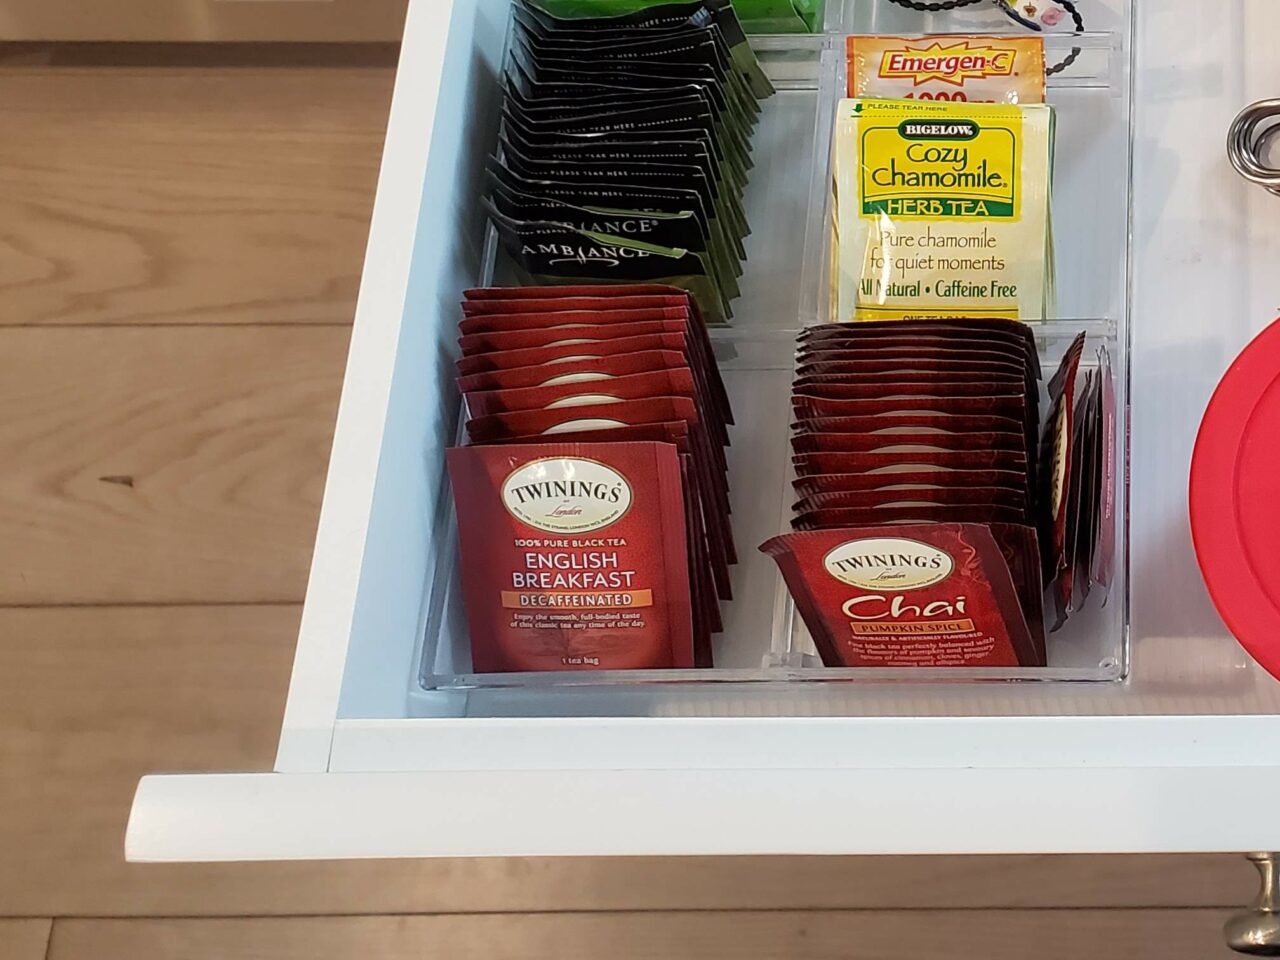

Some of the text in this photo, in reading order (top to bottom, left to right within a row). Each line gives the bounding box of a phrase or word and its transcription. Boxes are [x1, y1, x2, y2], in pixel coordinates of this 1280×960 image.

[888, 53, 1009, 75] Emergen-C
[905, 125, 973, 135] BIGELOW
[906, 143, 968, 171] Cozy
[872, 158, 1003, 188] Chamomile
[887, 200, 989, 216] HERB TEA
[880, 226, 997, 248] Pure chamomile
[895, 253, 934, 279] quiet
[937, 256, 1005, 270] moments
[860, 279, 873, 296] All
[935, 280, 988, 298] Caffeine
[990, 281, 1017, 297] Free
[511, 481, 621, 503] TWININGS
[515, 539, 541, 547] 100%
[572, 539, 604, 547] BLACK
[525, 552, 618, 569] ENGLISH
[832, 554, 942, 572] TWININGS
[512, 571, 635, 588] BREAKFAST
[520, 594, 632, 606] DECAFFEINATED
[842, 595, 966, 620] Chai
[862, 623, 923, 633] PUMPKIN
[583, 657, 599, 665] bag
